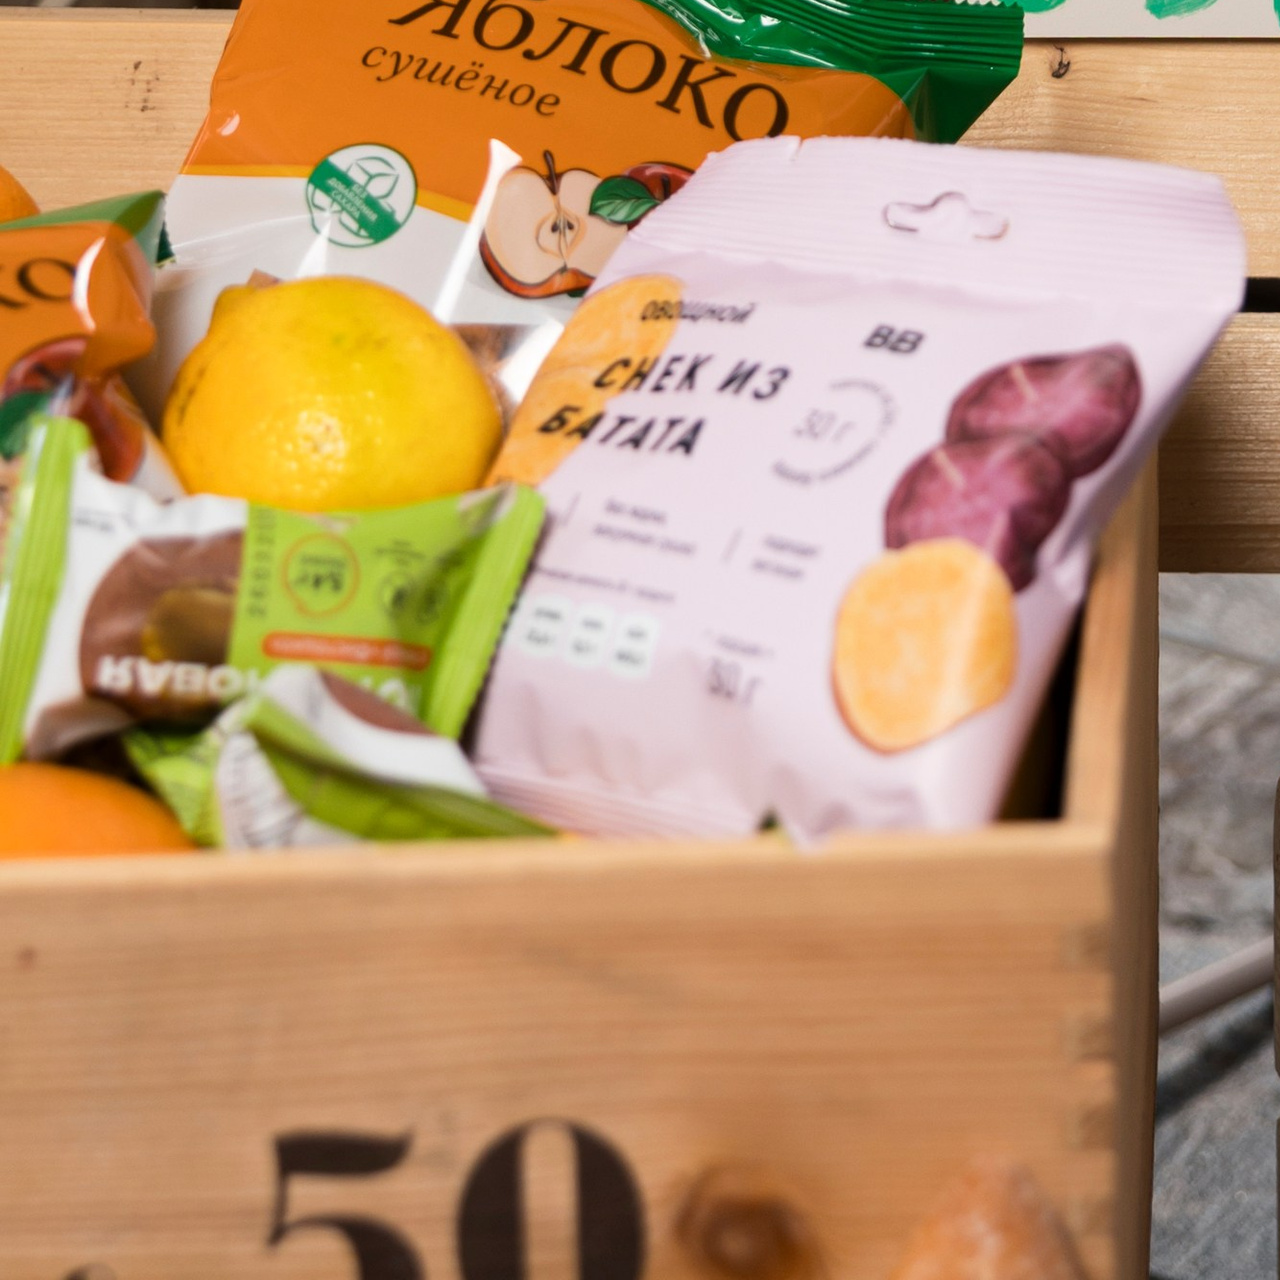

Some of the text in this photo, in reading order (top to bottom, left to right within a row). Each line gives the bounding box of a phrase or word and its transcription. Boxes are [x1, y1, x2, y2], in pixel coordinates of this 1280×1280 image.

[361, 43, 562, 117] сушёное
[593, 354, 793, 402] СНЕК ИЗ
[536, 405, 707, 458] БАТАТА
